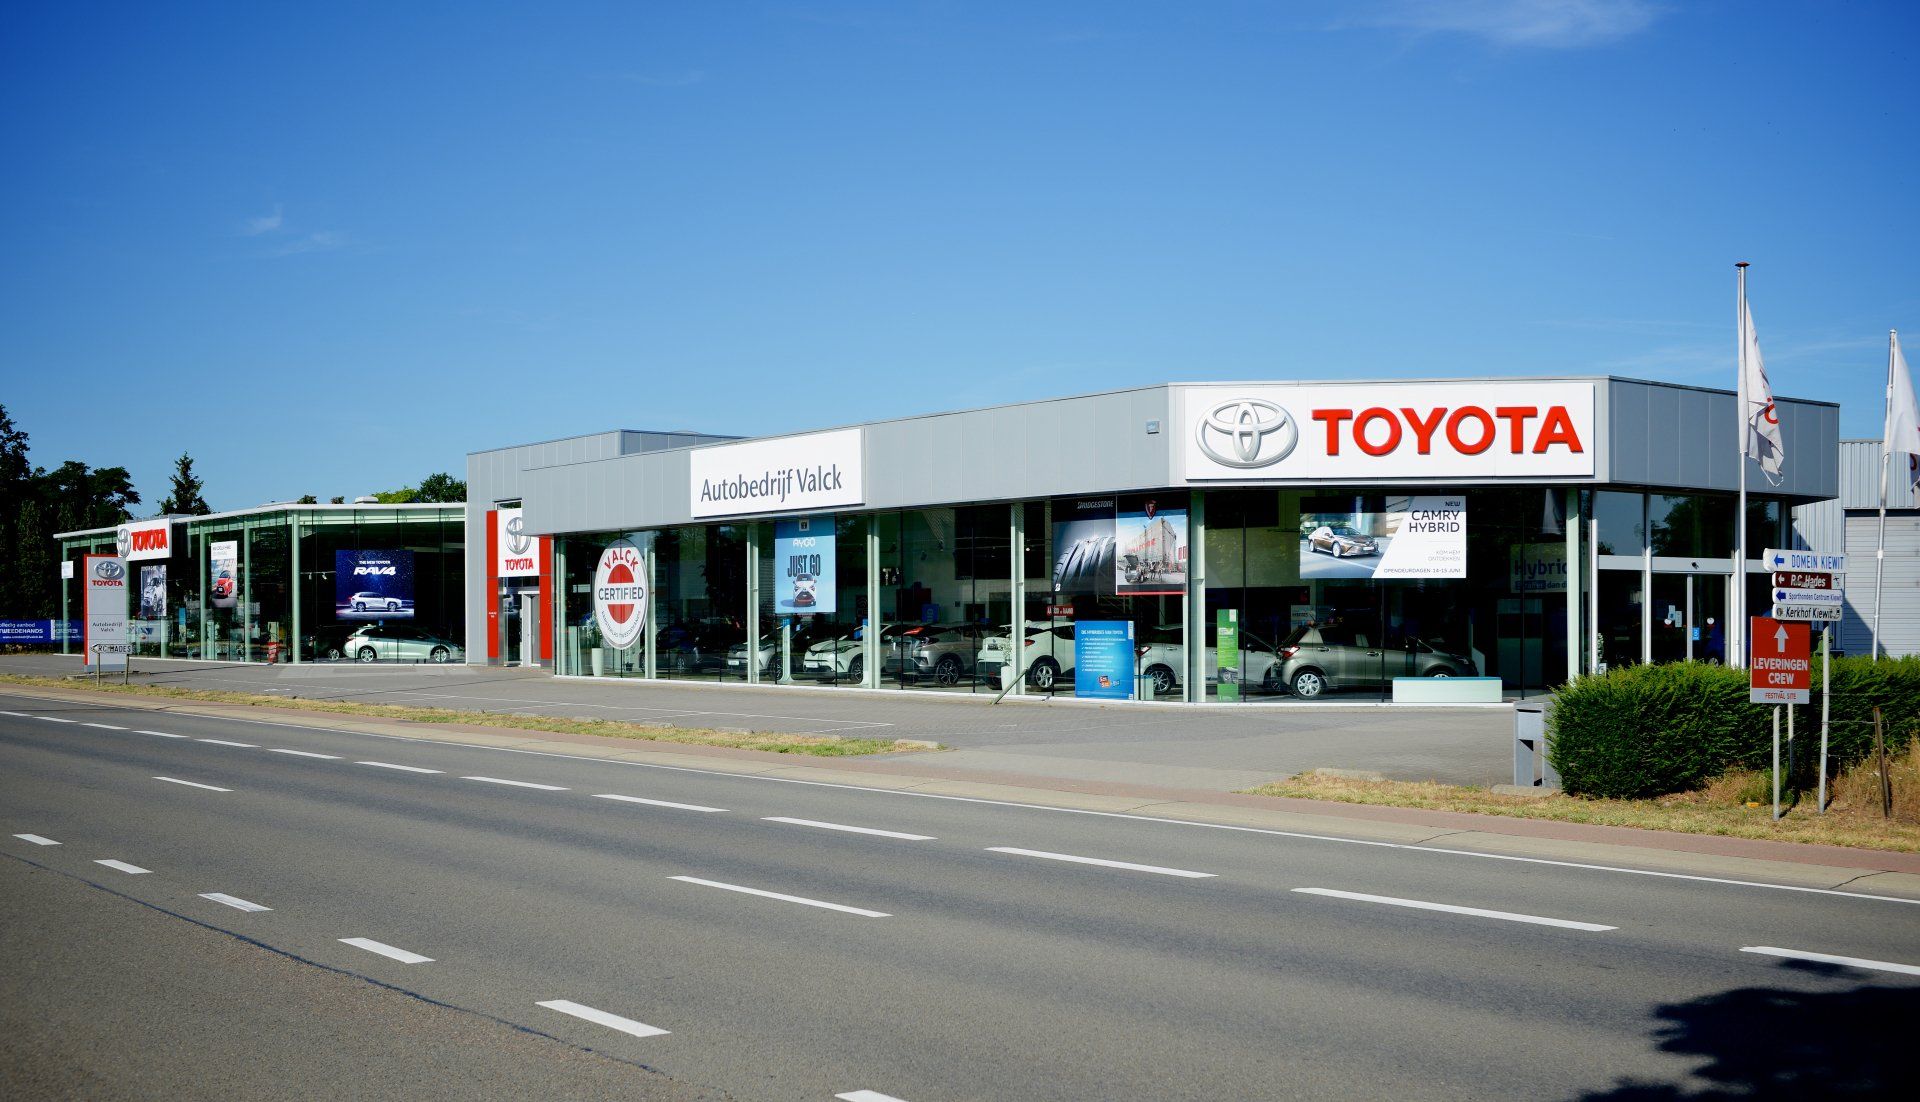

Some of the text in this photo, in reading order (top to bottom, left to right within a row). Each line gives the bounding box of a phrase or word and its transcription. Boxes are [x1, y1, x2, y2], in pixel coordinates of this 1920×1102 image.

[1312, 405, 1584, 456] TOYOTA
[701, 463, 842, 502] Autobedrijf Valck
[1077, 500, 1114, 509] BRIDGESTONE
[1411, 510, 1460, 521] CAMRY
[1409, 522, 1460, 532] HYBRID
[130, 528, 168, 552] TOYOTA
[792, 538, 816, 548] AYGO
[505, 558, 534, 570] TOYOTA
[604, 549, 639, 571] VALCK
[787, 554, 821, 577] JUST GO
[1791, 554, 1844, 569] DOMEIN KIEWIT
[354, 566, 396, 575] RAV4
[1805, 575, 1826, 588] Hades
[598, 587, 644, 600] CERTIFIED
[1786, 607, 1833, 619] Kerkhof Kiewit
[1753, 658, 1808, 671] LEVERINGEN
[1768, 673, 1795, 685] CREW
